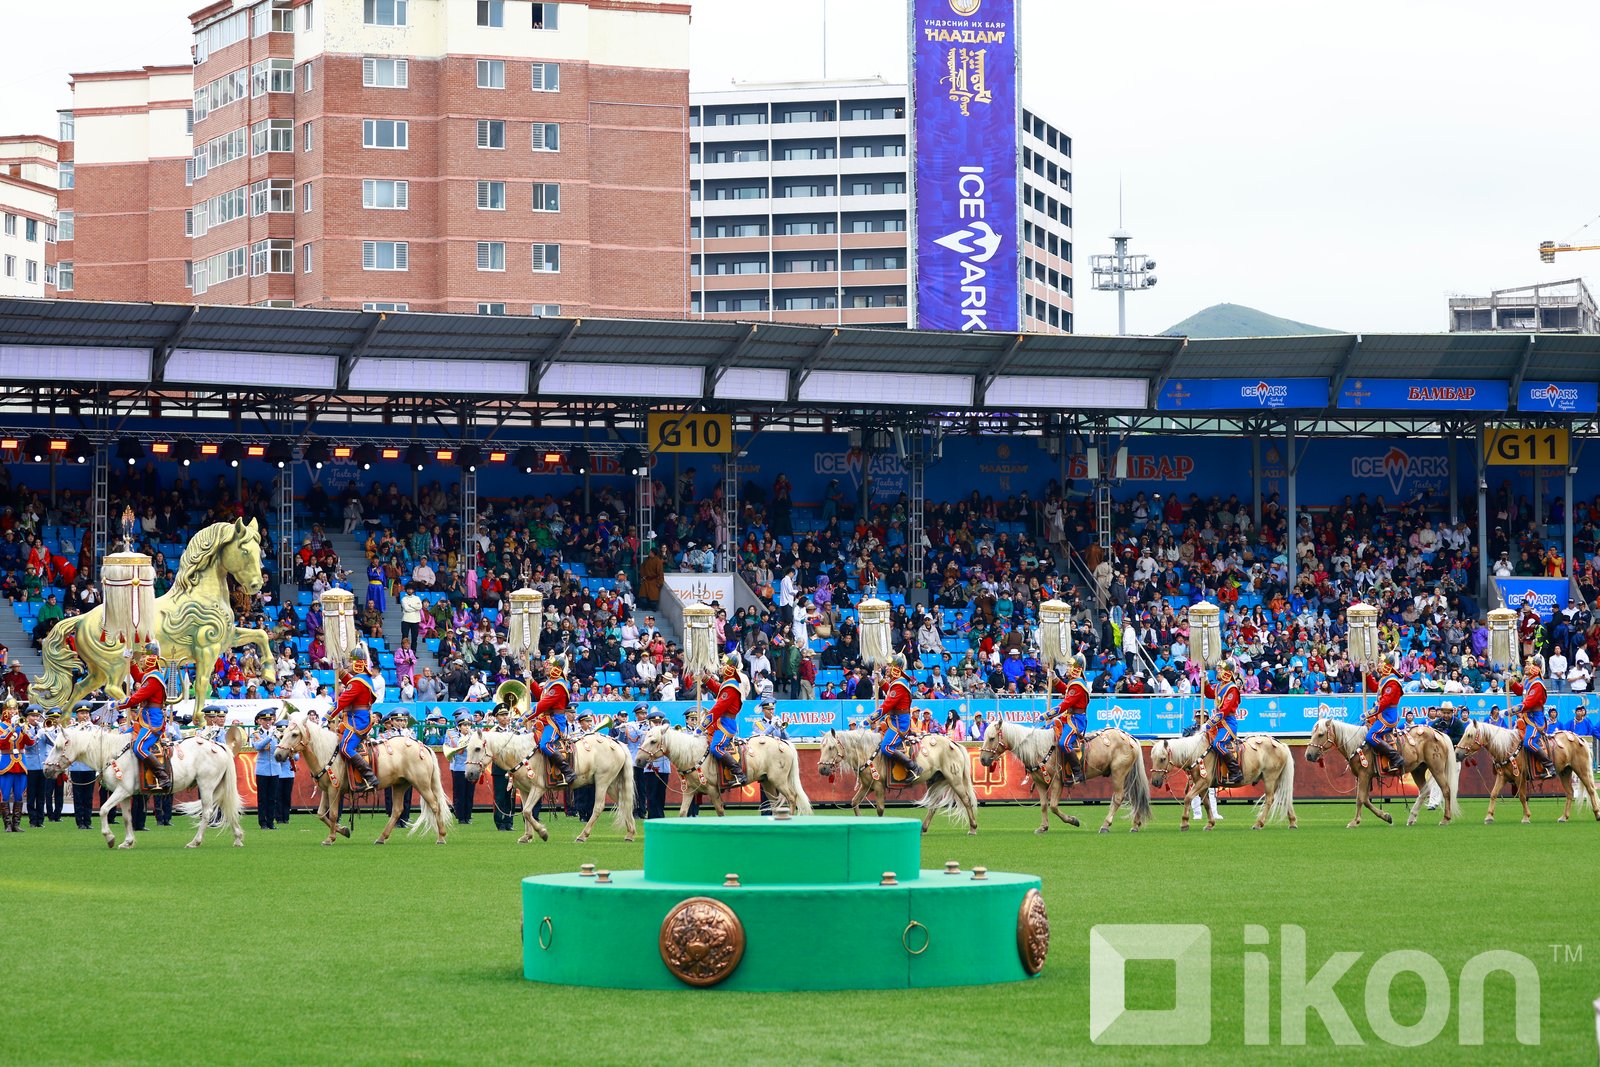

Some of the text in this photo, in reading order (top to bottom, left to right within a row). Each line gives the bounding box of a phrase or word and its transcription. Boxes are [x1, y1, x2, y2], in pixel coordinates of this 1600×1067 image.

[925, 28, 1006, 43] НААДАМ
[932, 166, 1003, 332] ICEMARK
[1241, 381, 1287, 405] ICEMARK
[1408, 386, 1475, 400] БАМБАР
[1531, 384, 1578, 407] ICEMARK
[659, 420, 720, 447] G10
[1498, 434, 1555, 459] G11
[781, 711, 836, 724] БАМБАР
[1304, 703, 1347, 719] ICEMARK
